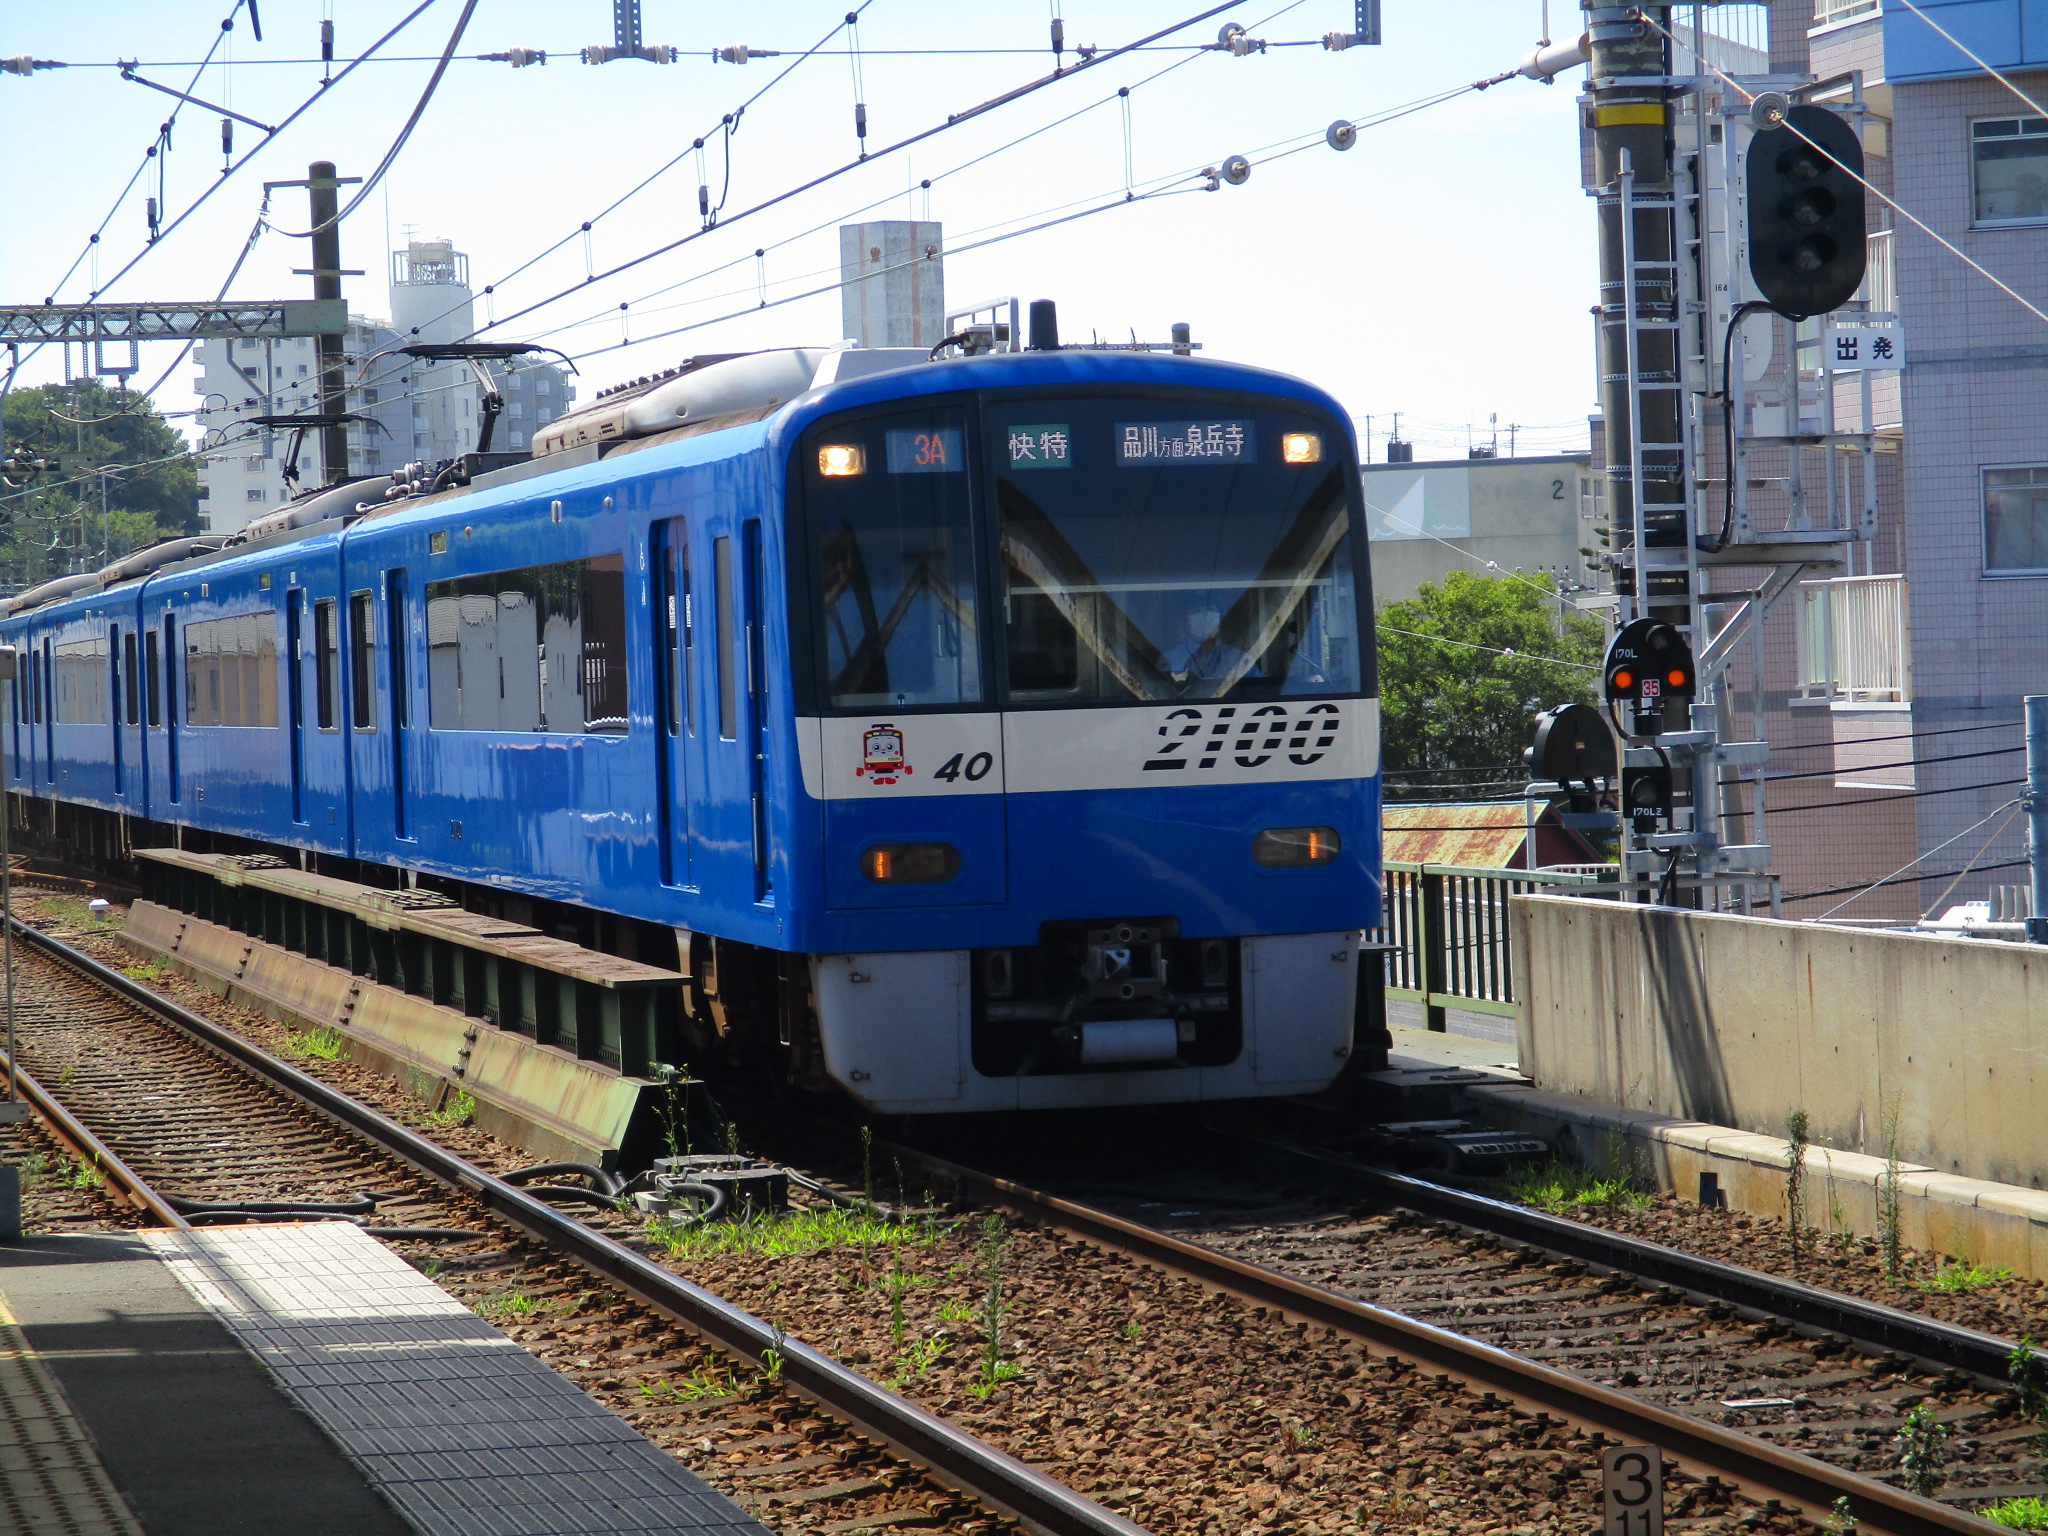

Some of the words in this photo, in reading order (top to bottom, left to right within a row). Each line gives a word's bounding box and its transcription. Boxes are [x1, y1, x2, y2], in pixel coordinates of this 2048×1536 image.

[1837, 336, 1894, 360] 出発
[914, 433, 946, 465] 3A
[1008, 431, 1067, 461] 快特
[1123, 423, 1244, 458] 品川方面泉岳寺
[1552, 479, 1565, 500] 2
[1615, 648, 1638, 659] 170L
[1643, 680, 1659, 696] 35
[1142, 703, 1340, 771] 2100
[933, 751, 993, 783] 40
[1633, 807, 1662, 817] 170LZ
[1612, 1453, 1653, 1507] 3
[1615, 1508, 1651, 1536] 11
